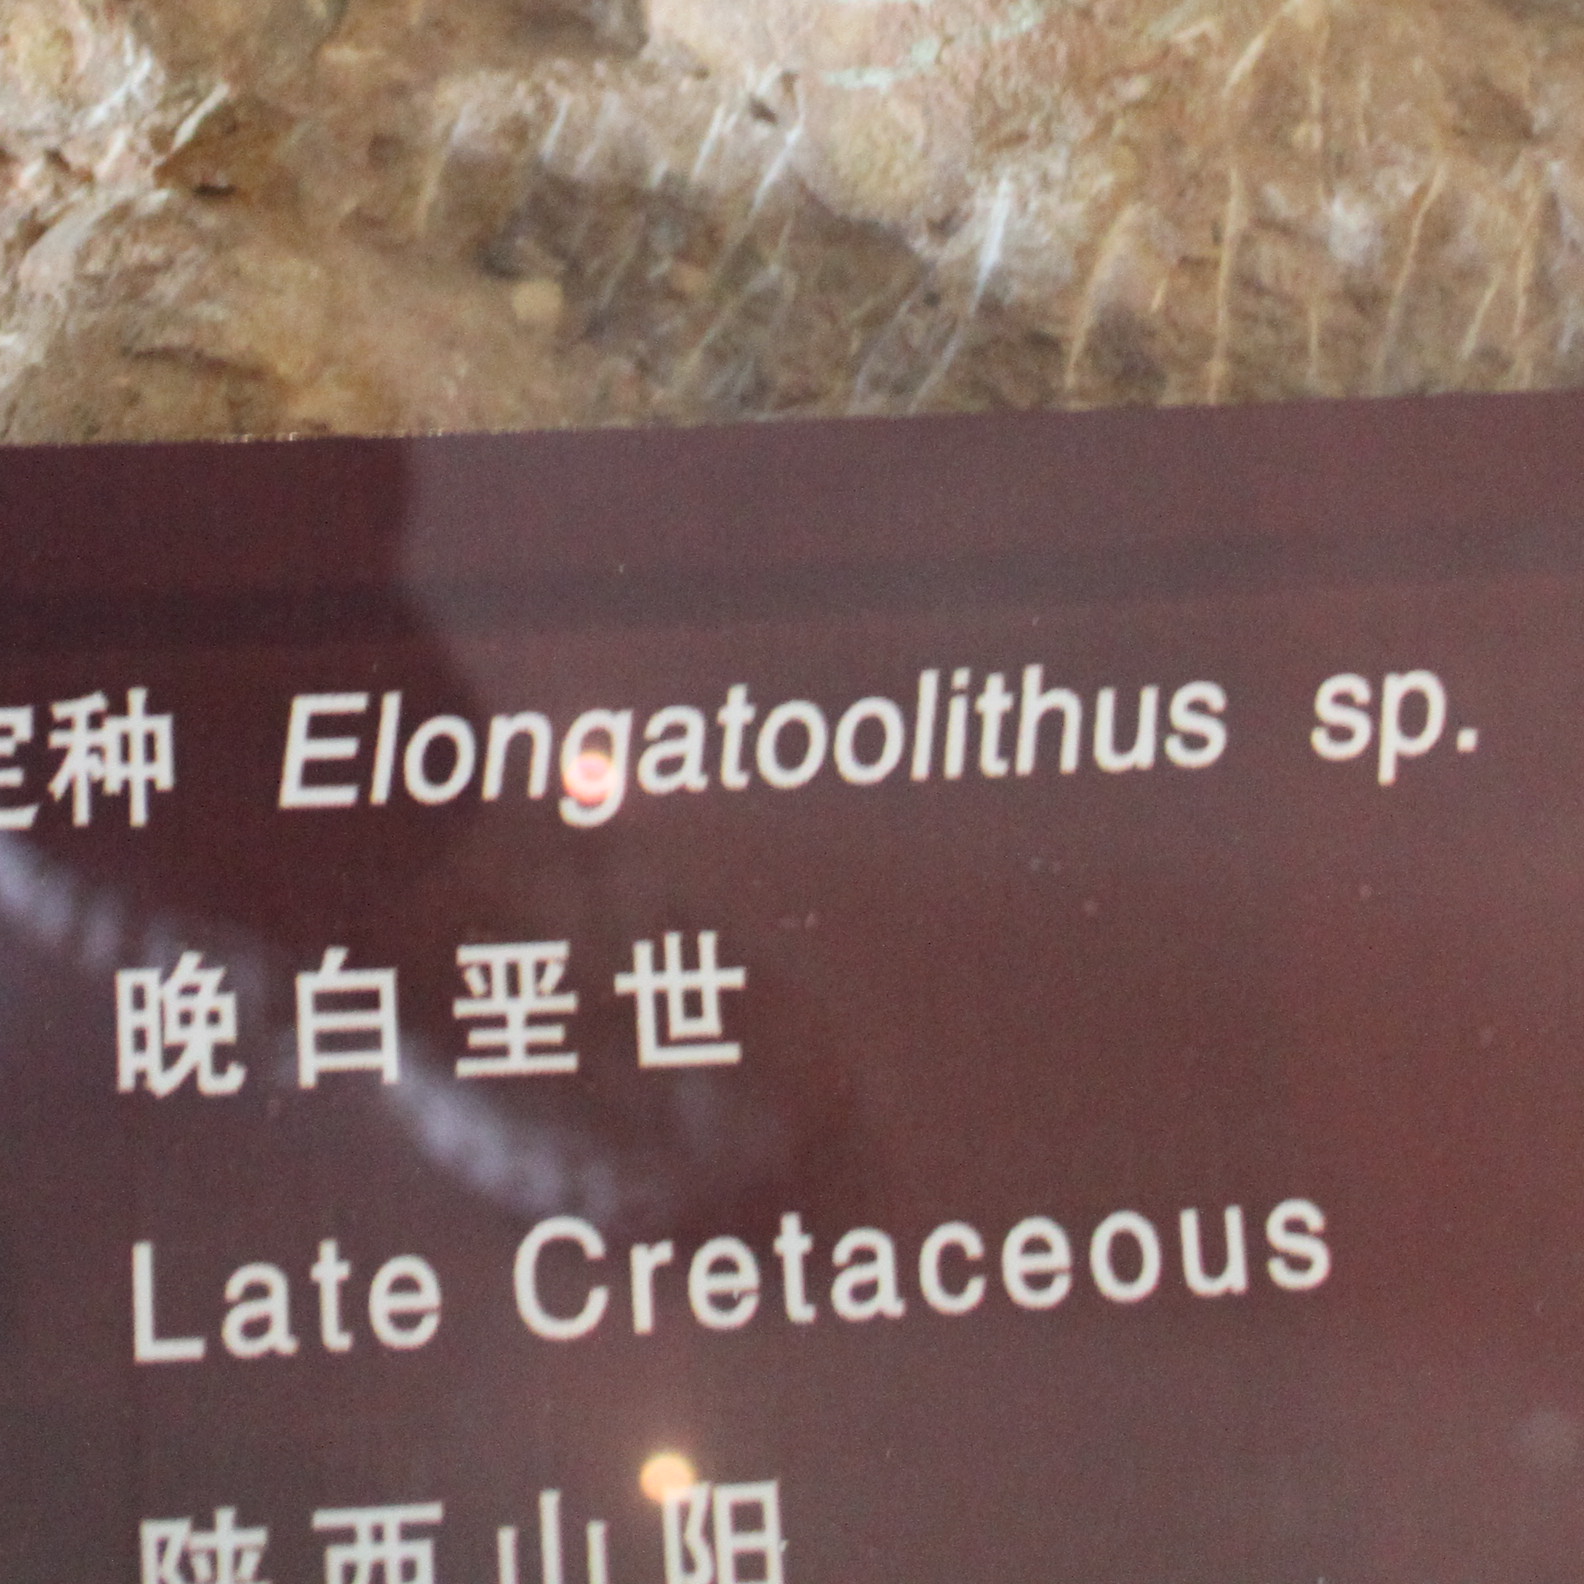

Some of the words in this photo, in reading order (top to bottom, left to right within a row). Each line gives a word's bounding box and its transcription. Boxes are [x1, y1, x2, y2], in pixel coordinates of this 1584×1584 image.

[277, 663, 1229, 828] Elongatoolithus
[1309, 669, 1480, 787] sp.
[113, 930, 748, 1100] 晚白垩世
[130, 1238, 443, 1364] Late
[512, 1198, 1332, 1342] Cretaceous
